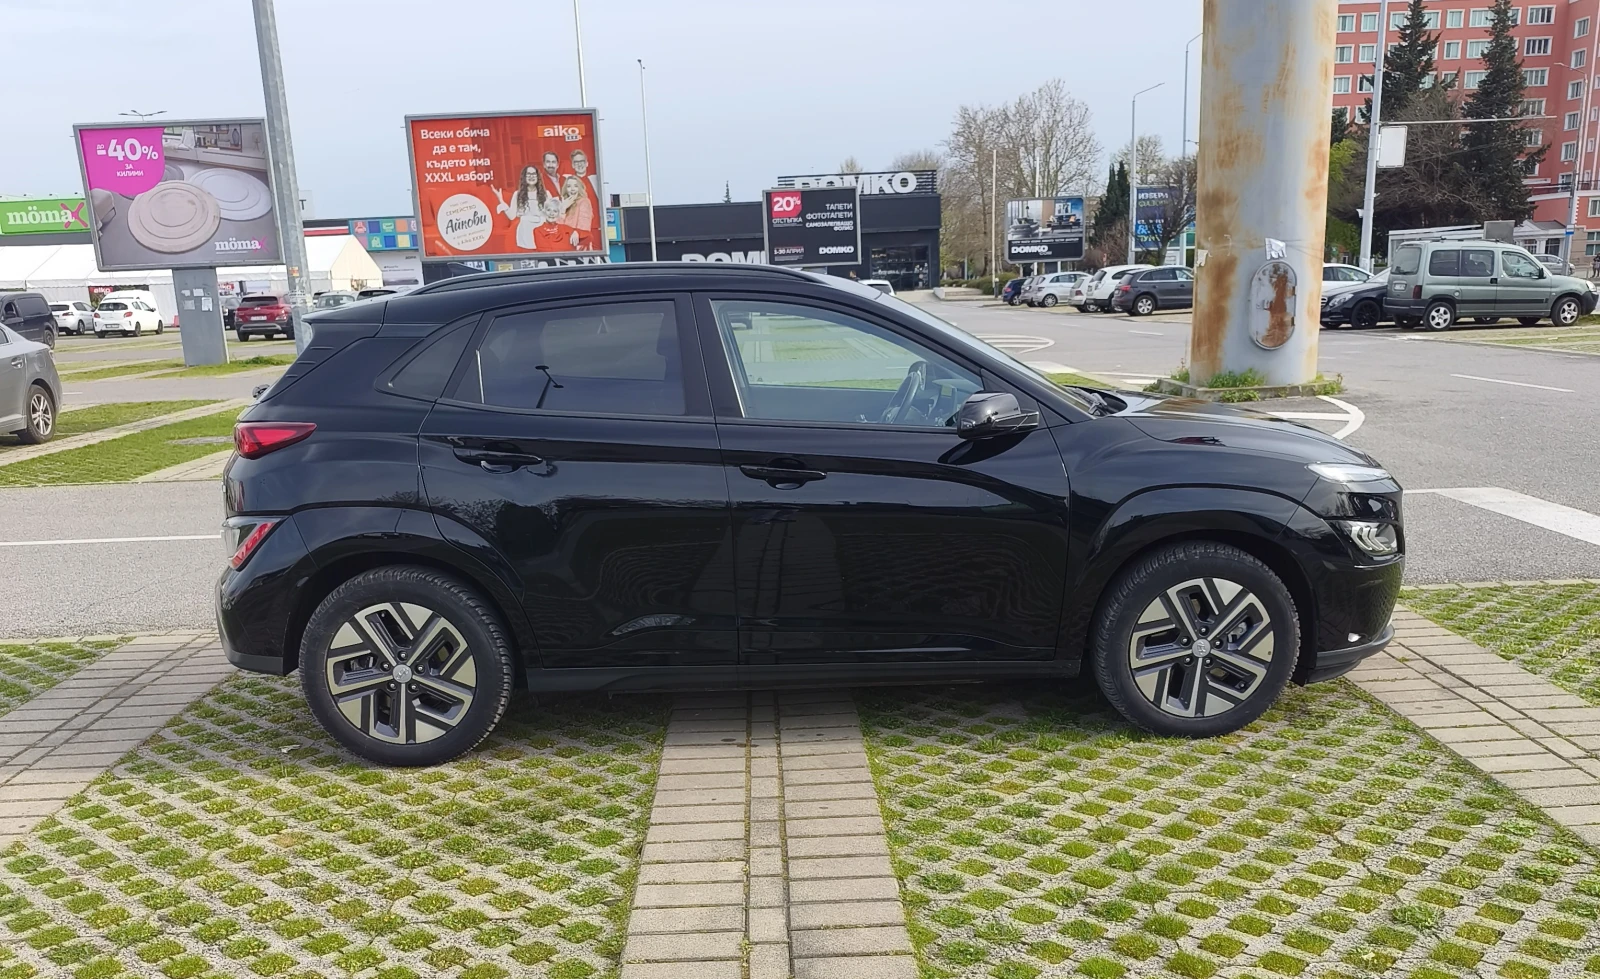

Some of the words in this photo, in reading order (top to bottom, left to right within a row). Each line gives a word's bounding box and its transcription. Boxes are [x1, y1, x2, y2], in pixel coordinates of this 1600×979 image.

[421, 129, 453, 139] Всеки
[456, 127, 490, 138] обича
[543, 125, 579, 137] aiko
[432, 145, 447, 155] да
[449, 145, 456, 153] е
[457, 144, 481, 153] там,
[426, 159, 467, 169] където
[469, 158, 490, 166] има
[425, 172, 454, 183] XXXL
[457, 170, 493, 183] избор!
[773, 196, 802, 212] 20%
[825, 203, 853, 211] ТАПЕТИ
[805, 211, 853, 220] ФОТОТАПЕТИ
[446, 211, 486, 234] Айкови
[819, 246, 854, 254] DOMKO
[1011, 245, 1049, 254] DOMKO
